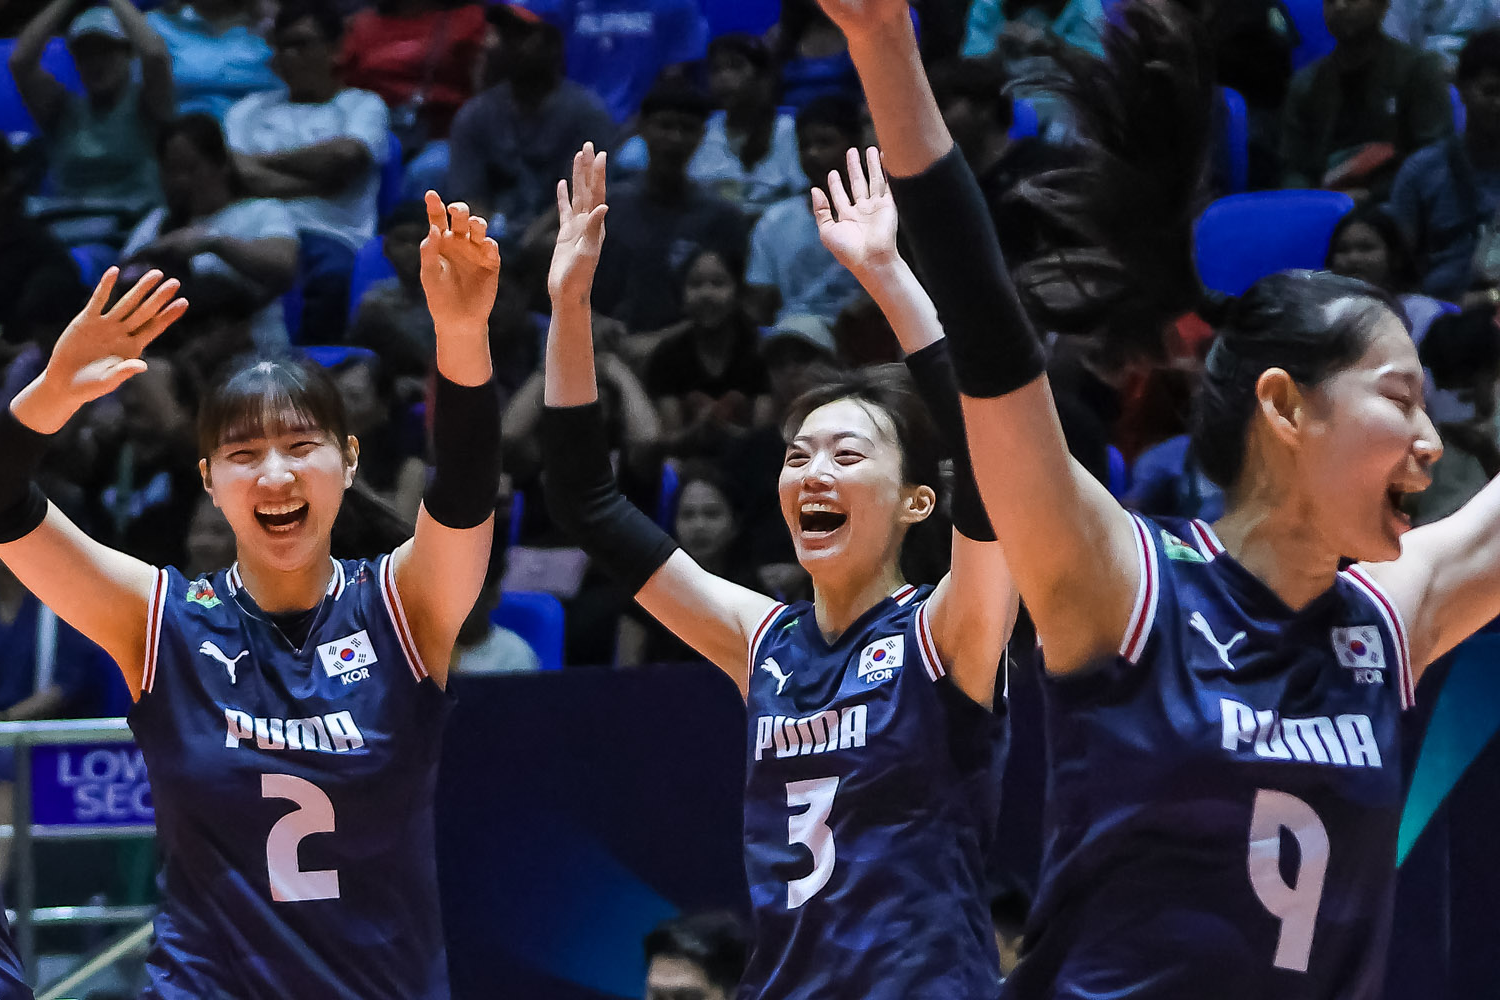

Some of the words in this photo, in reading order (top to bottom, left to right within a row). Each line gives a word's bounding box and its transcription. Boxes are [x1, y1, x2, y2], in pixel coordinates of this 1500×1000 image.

[341, 667, 370, 686] KOR
[866, 668, 893, 684] KOR
[1355, 669, 1384, 684] KOR
[224, 707, 365, 752] PUMA
[755, 704, 868, 761] PUMA
[1220, 697, 1384, 768] PUMA
[260, 773, 341, 902] 2
[785, 776, 840, 910] 3
[1248, 788, 1331, 973] 9
